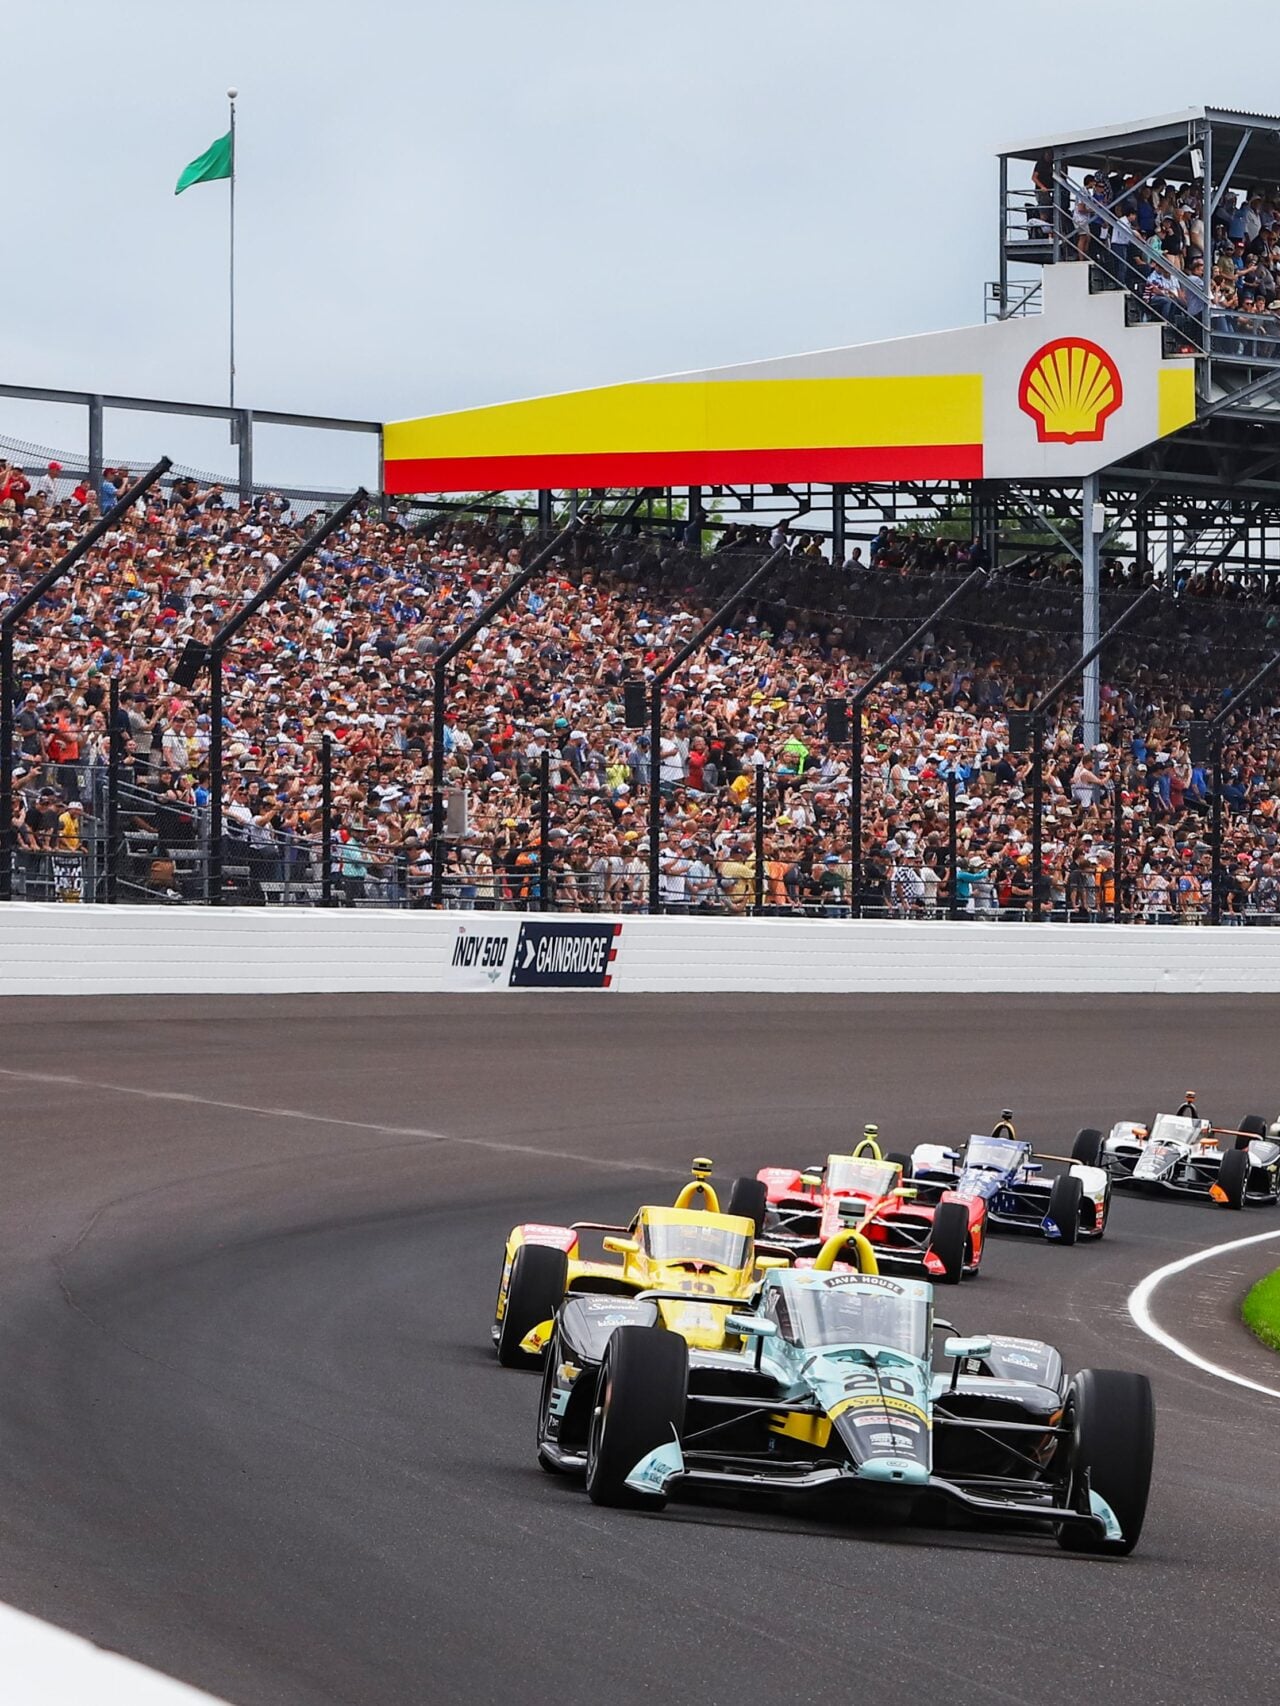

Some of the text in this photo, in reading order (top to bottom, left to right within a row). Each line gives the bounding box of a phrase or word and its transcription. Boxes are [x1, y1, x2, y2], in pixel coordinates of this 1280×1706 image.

[452, 936, 509, 967] INDY 500
[536, 936, 608, 973] GAINBRIDGE
[829, 1276, 901, 1292] JAVA HOUSE
[588, 1303, 639, 1311] Splenda
[843, 1373, 914, 1397] 20
